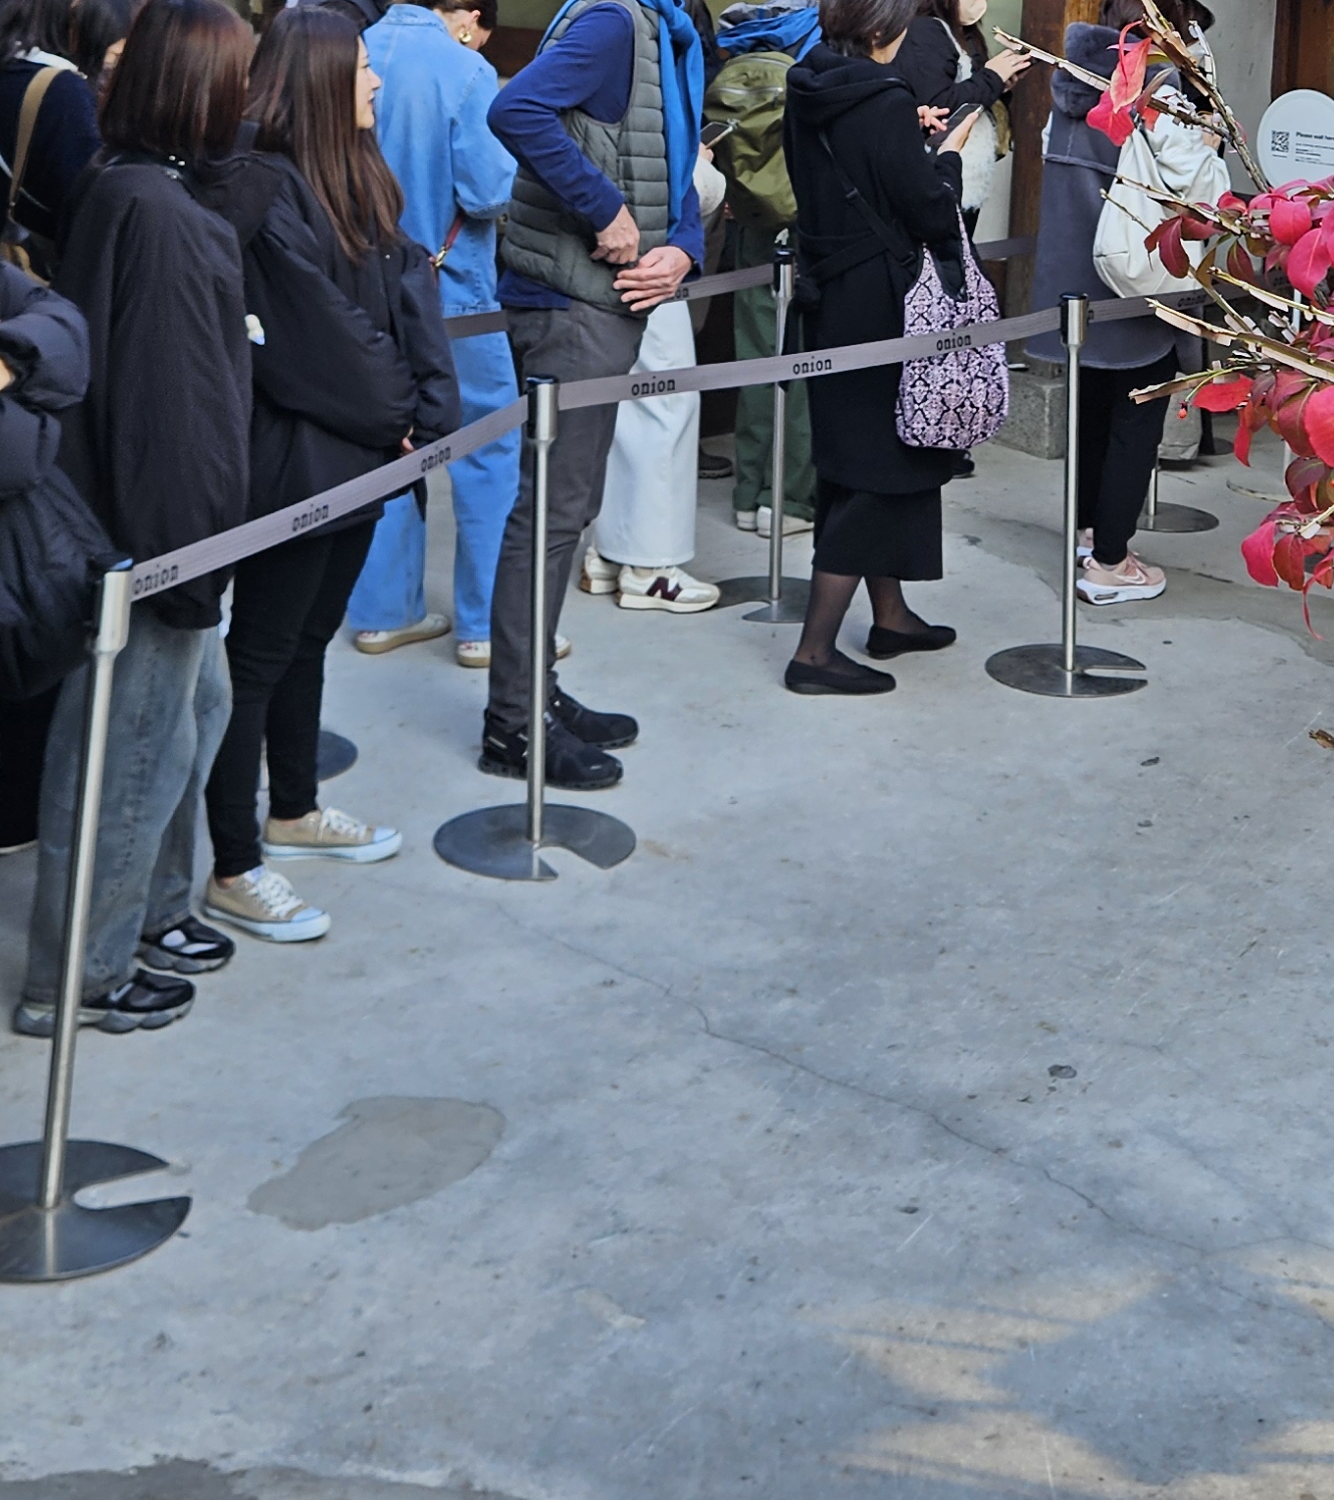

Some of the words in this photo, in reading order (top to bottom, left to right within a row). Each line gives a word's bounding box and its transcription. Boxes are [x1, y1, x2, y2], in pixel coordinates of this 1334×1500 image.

[935, 332, 972, 351] onion
[792, 356, 833, 375] onion
[630, 375, 676, 396] onion
[420, 445, 452, 473] onion
[292, 503, 329, 532] onion
[132, 564, 179, 596] onion
